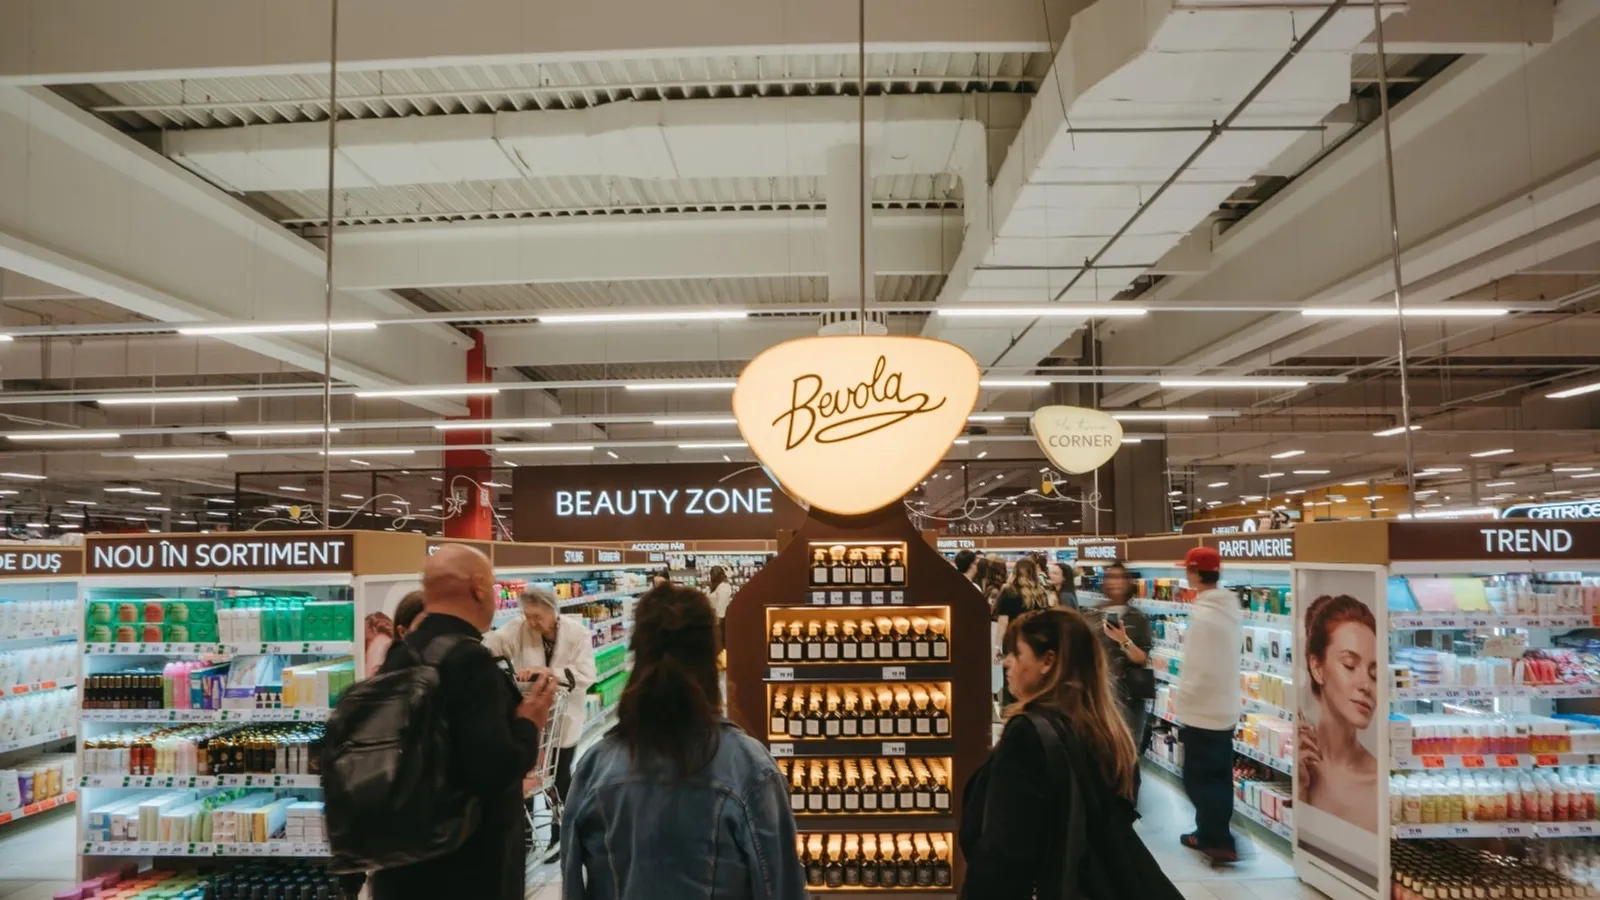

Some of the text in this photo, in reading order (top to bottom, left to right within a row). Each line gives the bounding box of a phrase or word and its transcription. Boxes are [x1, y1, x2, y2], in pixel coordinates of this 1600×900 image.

[772, 355, 946, 450] Bevola
[1048, 434, 1113, 447] CORNER
[556, 488, 773, 516] BEAUTY ZONE
[1219, 538, 1293, 557] PARFUMERIE
[1480, 528, 1573, 553] TREND
[0, 553, 17, 570] E
[94, 540, 345, 569] NOU ÎN SORTIMENT
